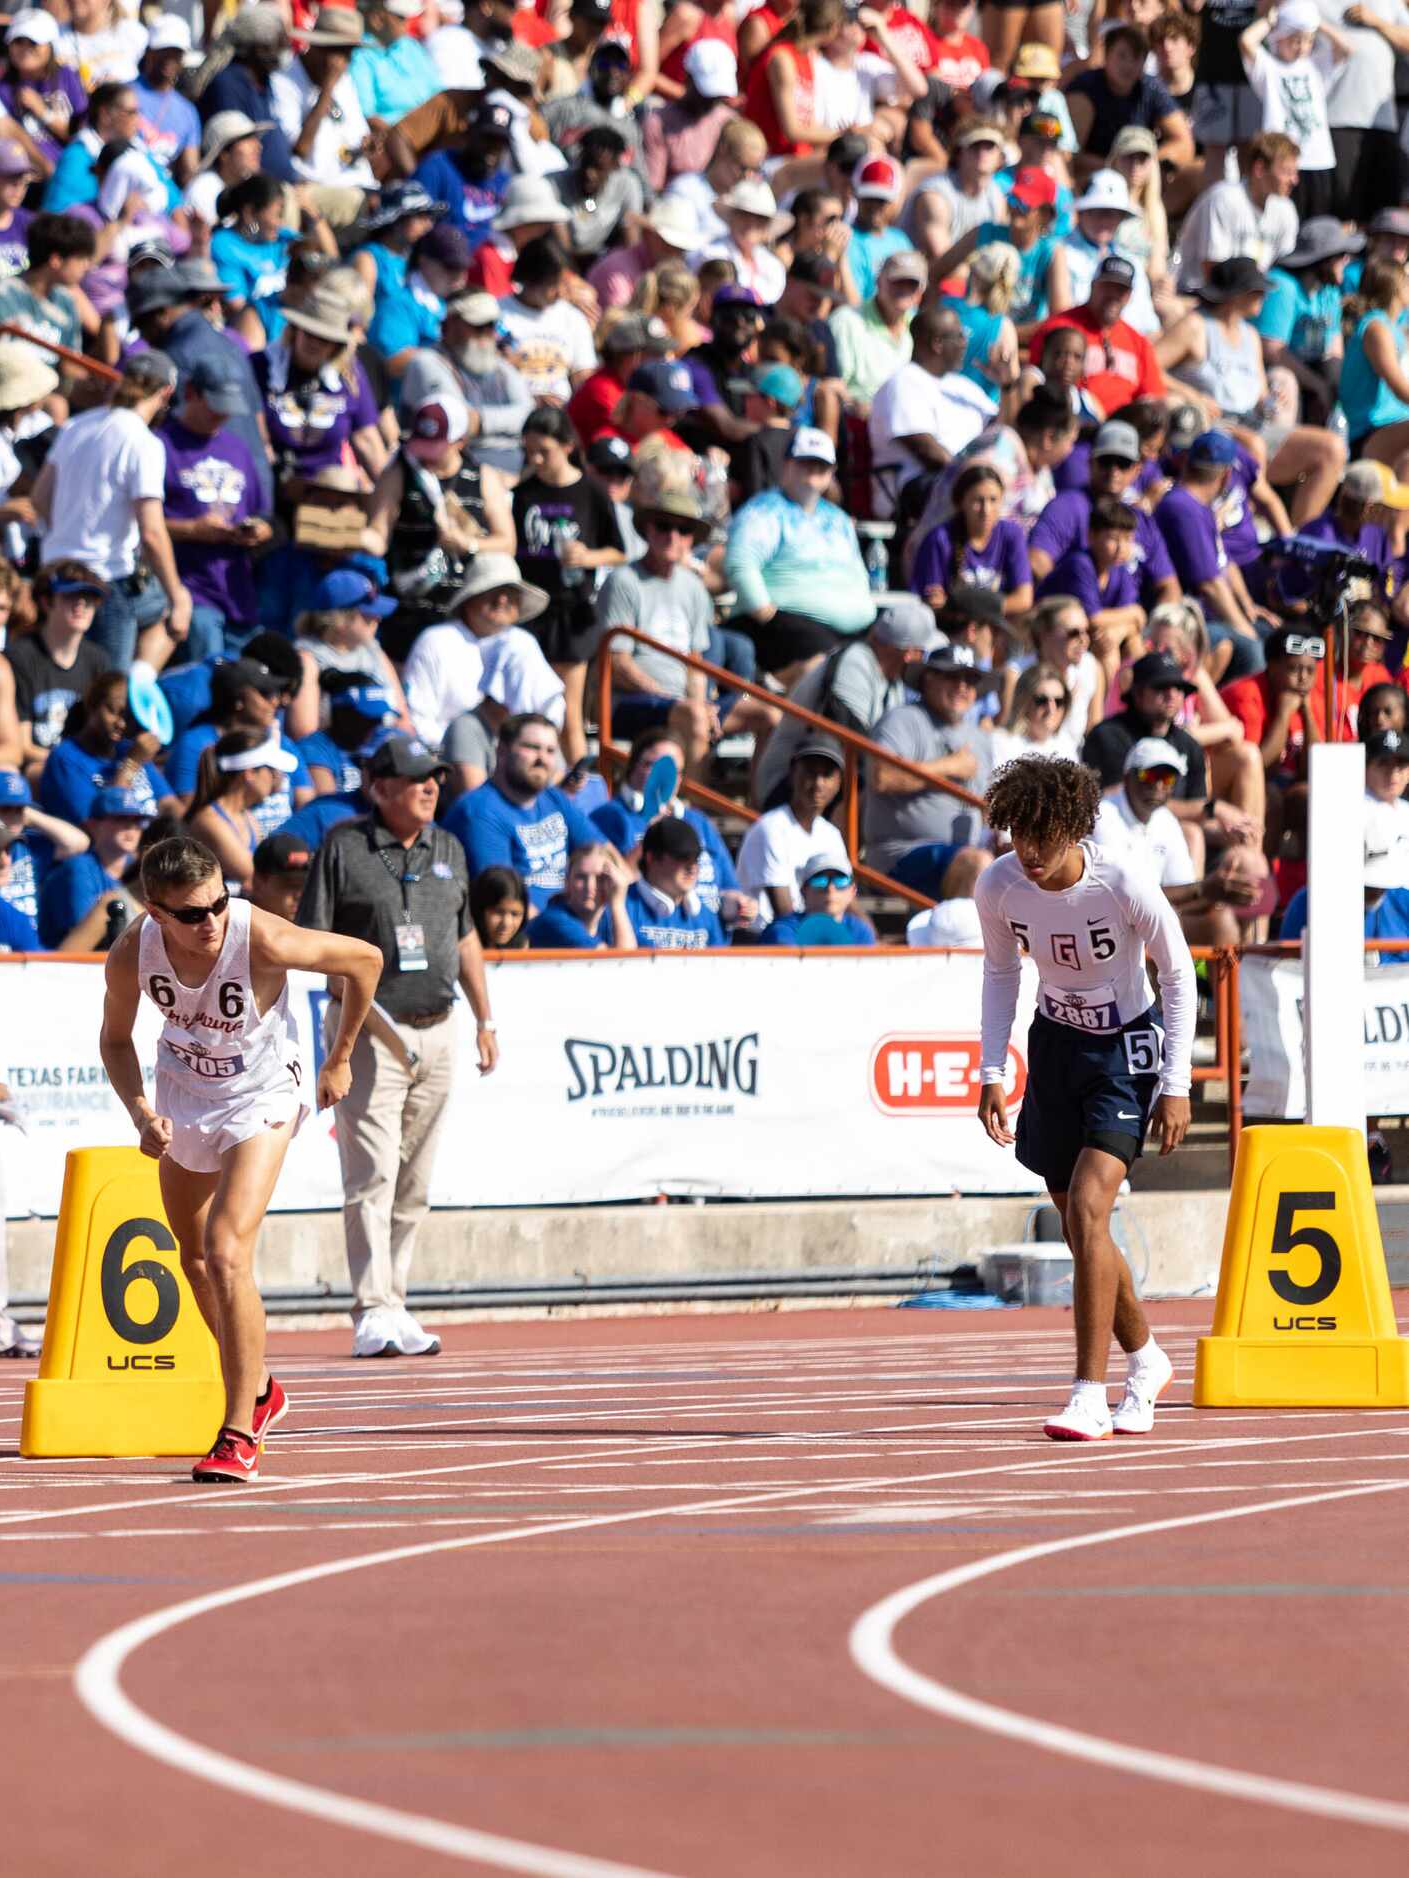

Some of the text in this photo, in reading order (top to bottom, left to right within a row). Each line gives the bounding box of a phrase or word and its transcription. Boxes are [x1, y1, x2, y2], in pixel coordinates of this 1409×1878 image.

[1089, 927, 1117, 961] 5
[149, 974, 176, 1008] 6
[218, 981, 244, 1019] 6
[1051, 1001, 1110, 1028] 2887
[564, 1032, 759, 1101] SPALDING
[1128, 1032, 1154, 1070] 5
[7, 1066, 63, 1088] TEXAS
[1267, 1191, 1342, 1306] 5
[100, 1217, 181, 1345] 6
[1273, 1316, 1338, 1331] UCS
[106, 1355, 176, 1371] UCS
